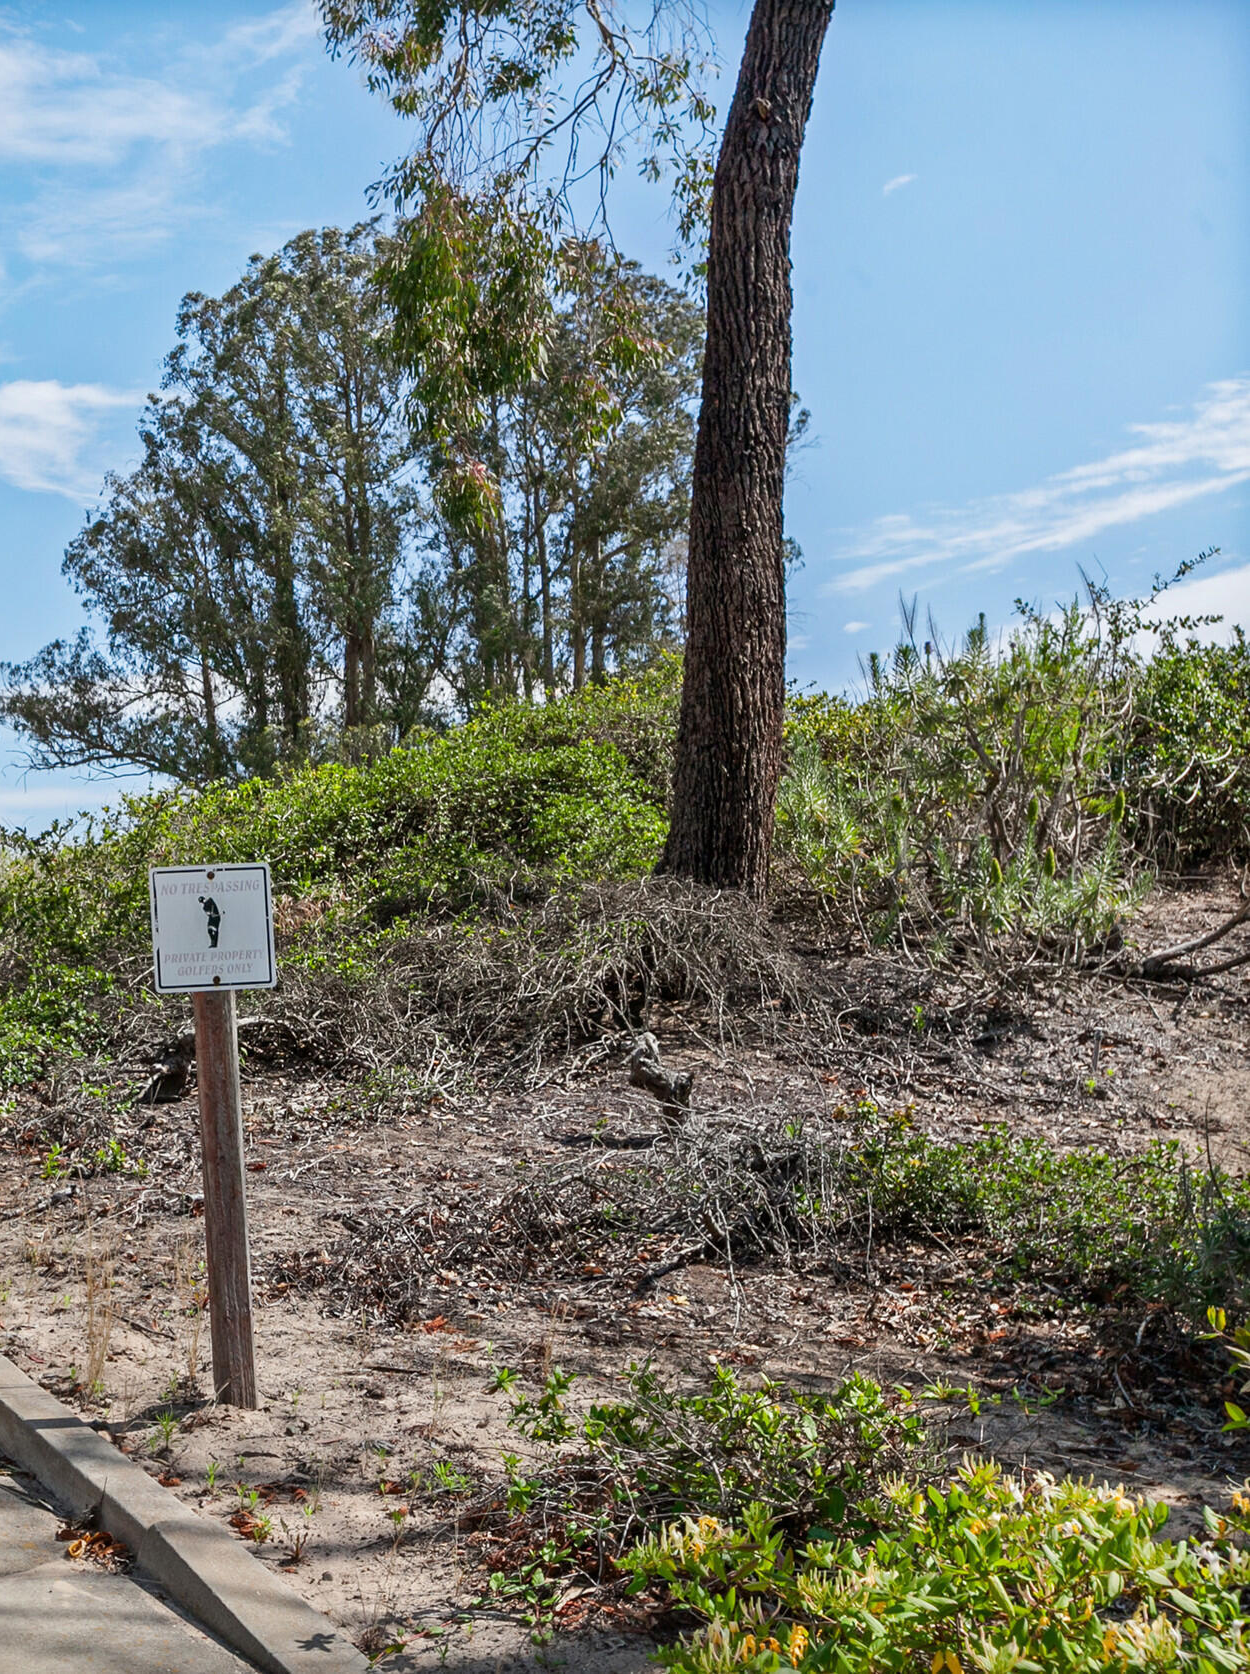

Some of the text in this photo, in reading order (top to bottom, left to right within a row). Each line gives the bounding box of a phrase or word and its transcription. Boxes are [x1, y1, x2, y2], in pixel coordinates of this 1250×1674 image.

[161, 880, 260, 895] NO TRESPASSING
[164, 952, 207, 963] PRIVATE
[178, 962, 253, 976] GOLFERS ONLY
